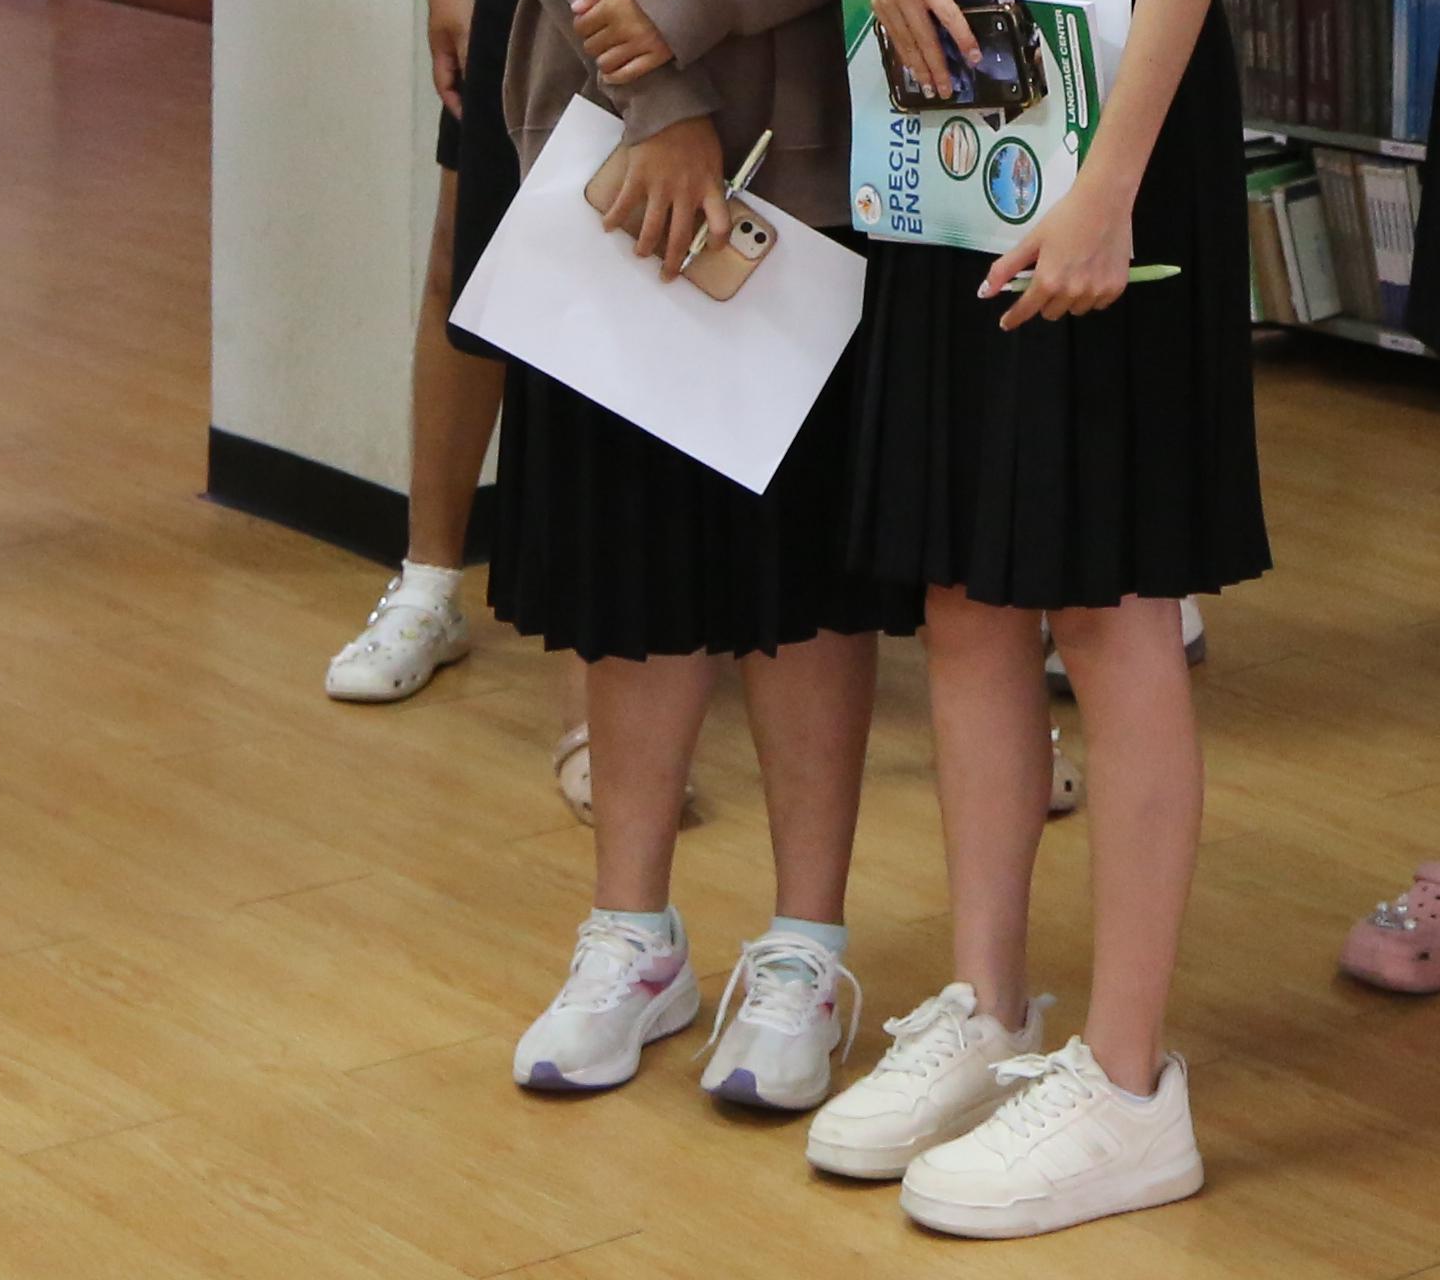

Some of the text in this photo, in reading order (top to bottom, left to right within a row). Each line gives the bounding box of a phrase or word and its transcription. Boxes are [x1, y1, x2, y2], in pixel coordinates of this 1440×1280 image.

[1055, 9, 1076, 123] LANGUAGE CENTER
[905, 117, 923, 234] ENGLIS
